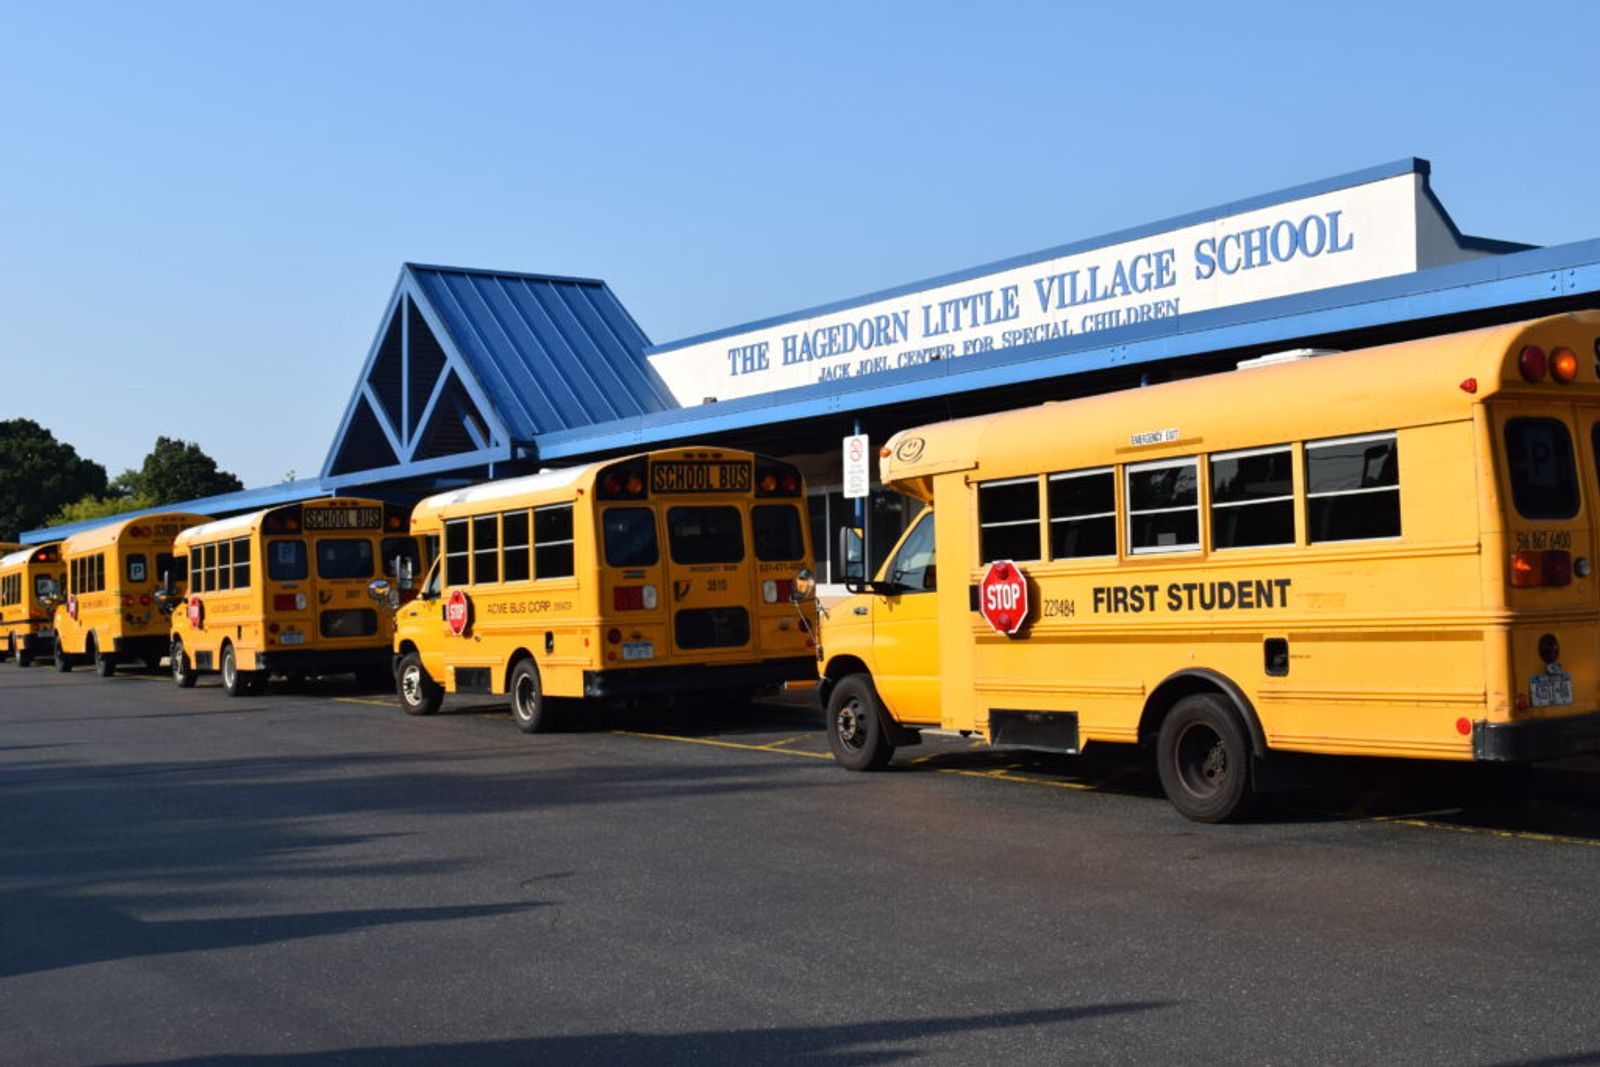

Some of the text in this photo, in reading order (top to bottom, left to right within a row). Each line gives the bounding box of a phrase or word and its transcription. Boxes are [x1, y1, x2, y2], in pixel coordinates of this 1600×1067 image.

[728, 210, 1354, 376] THE HAGEDORN LITTLE VILLAGE SCHOOL
[818, 298, 1180, 384] JACK JOEL CENTER FOR SPECIAL CHILDREN
[1131, 429, 1179, 445] EMERGENCY EXIT
[655, 463, 748, 489] SCHOOL BUS
[305, 508, 380, 529] SCHOOL BUS
[133, 565, 143, 578] P
[487, 601, 508, 614] ACME
[509, 601, 526, 614] BUS
[987, 583, 1020, 610] STOP
[1092, 578, 1292, 614] FIRST STUDENT
[1043, 600, 1075, 617] 229484
